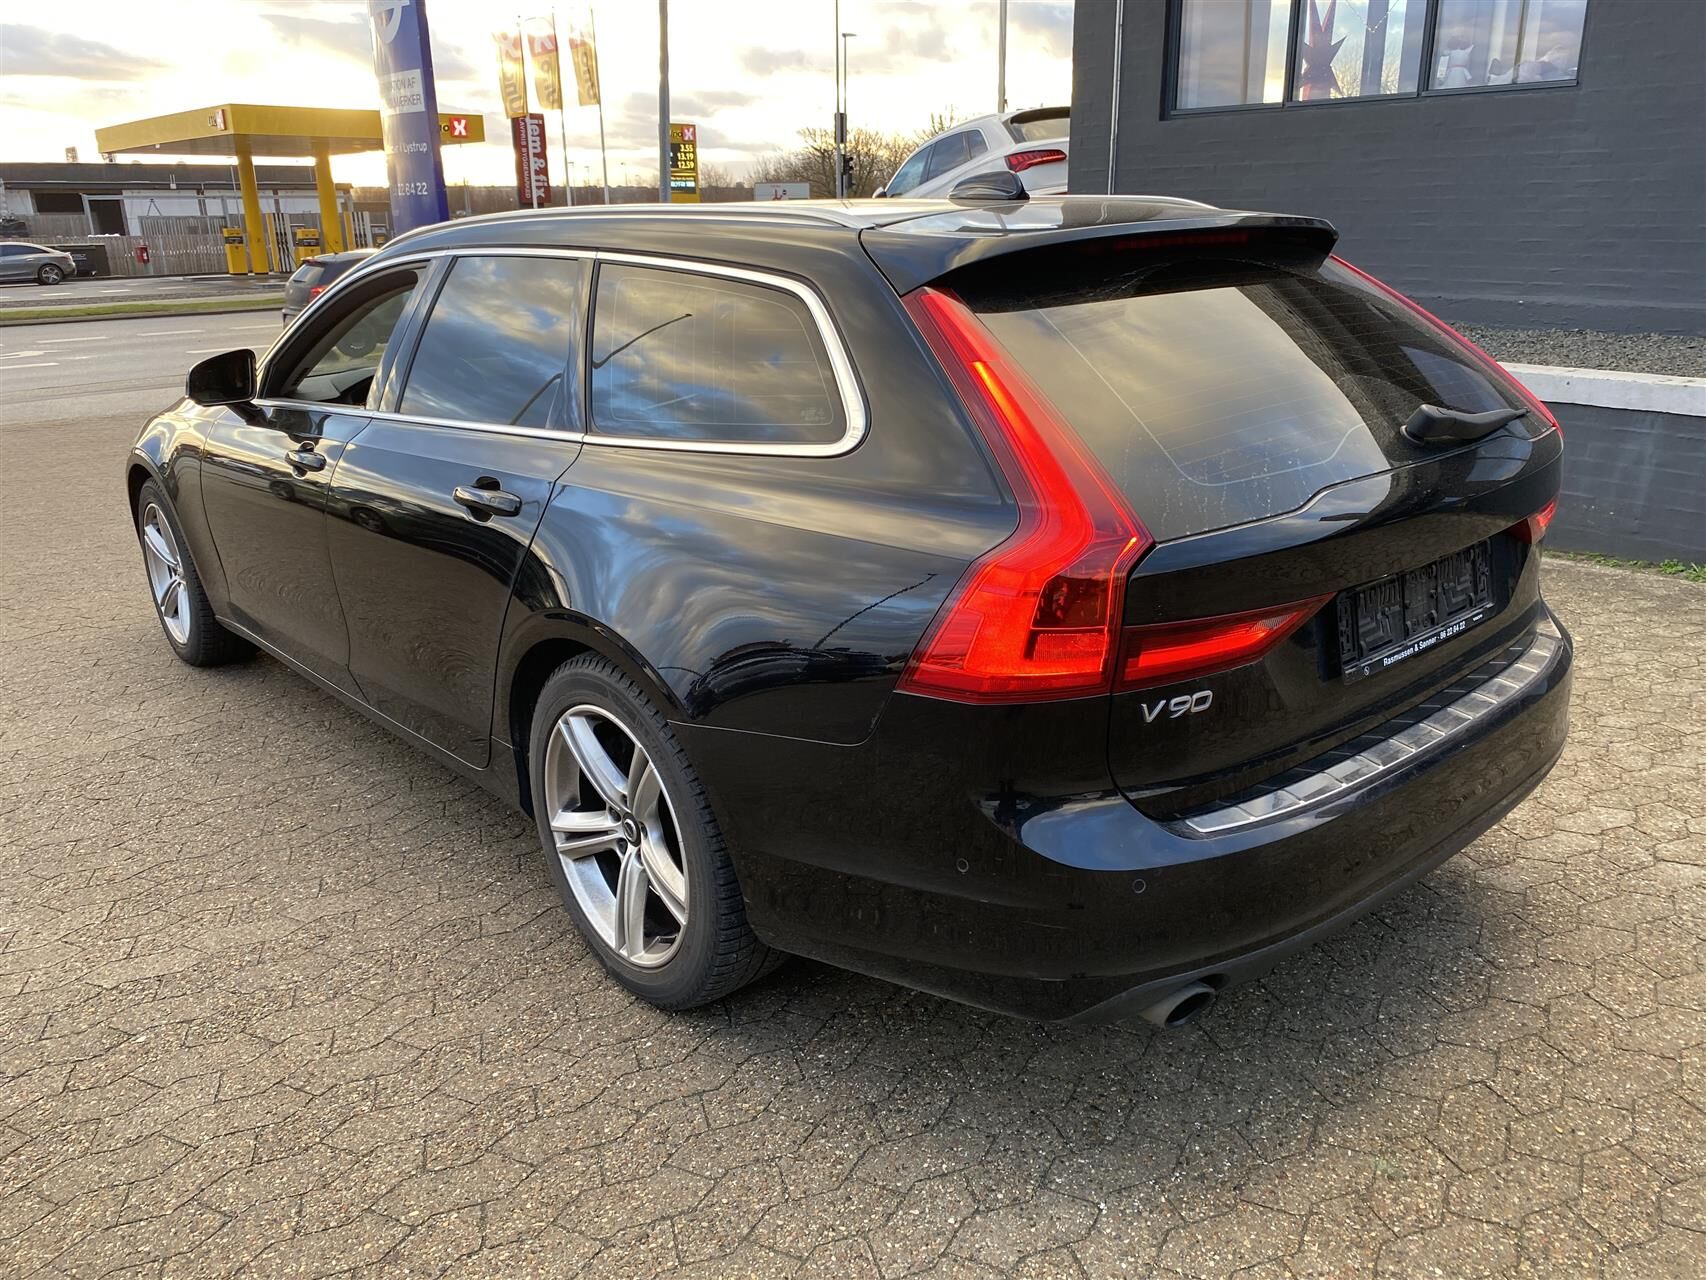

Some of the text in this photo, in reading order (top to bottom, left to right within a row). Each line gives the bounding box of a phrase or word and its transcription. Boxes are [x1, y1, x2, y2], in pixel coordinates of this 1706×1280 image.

[403, 141, 428, 155] Lystrup
[416, 182, 429, 195] 22
[535, 174, 548, 197] fix
[1383, 647, 1414, 667] Rasmussen
[1140, 690, 1213, 723] V90
